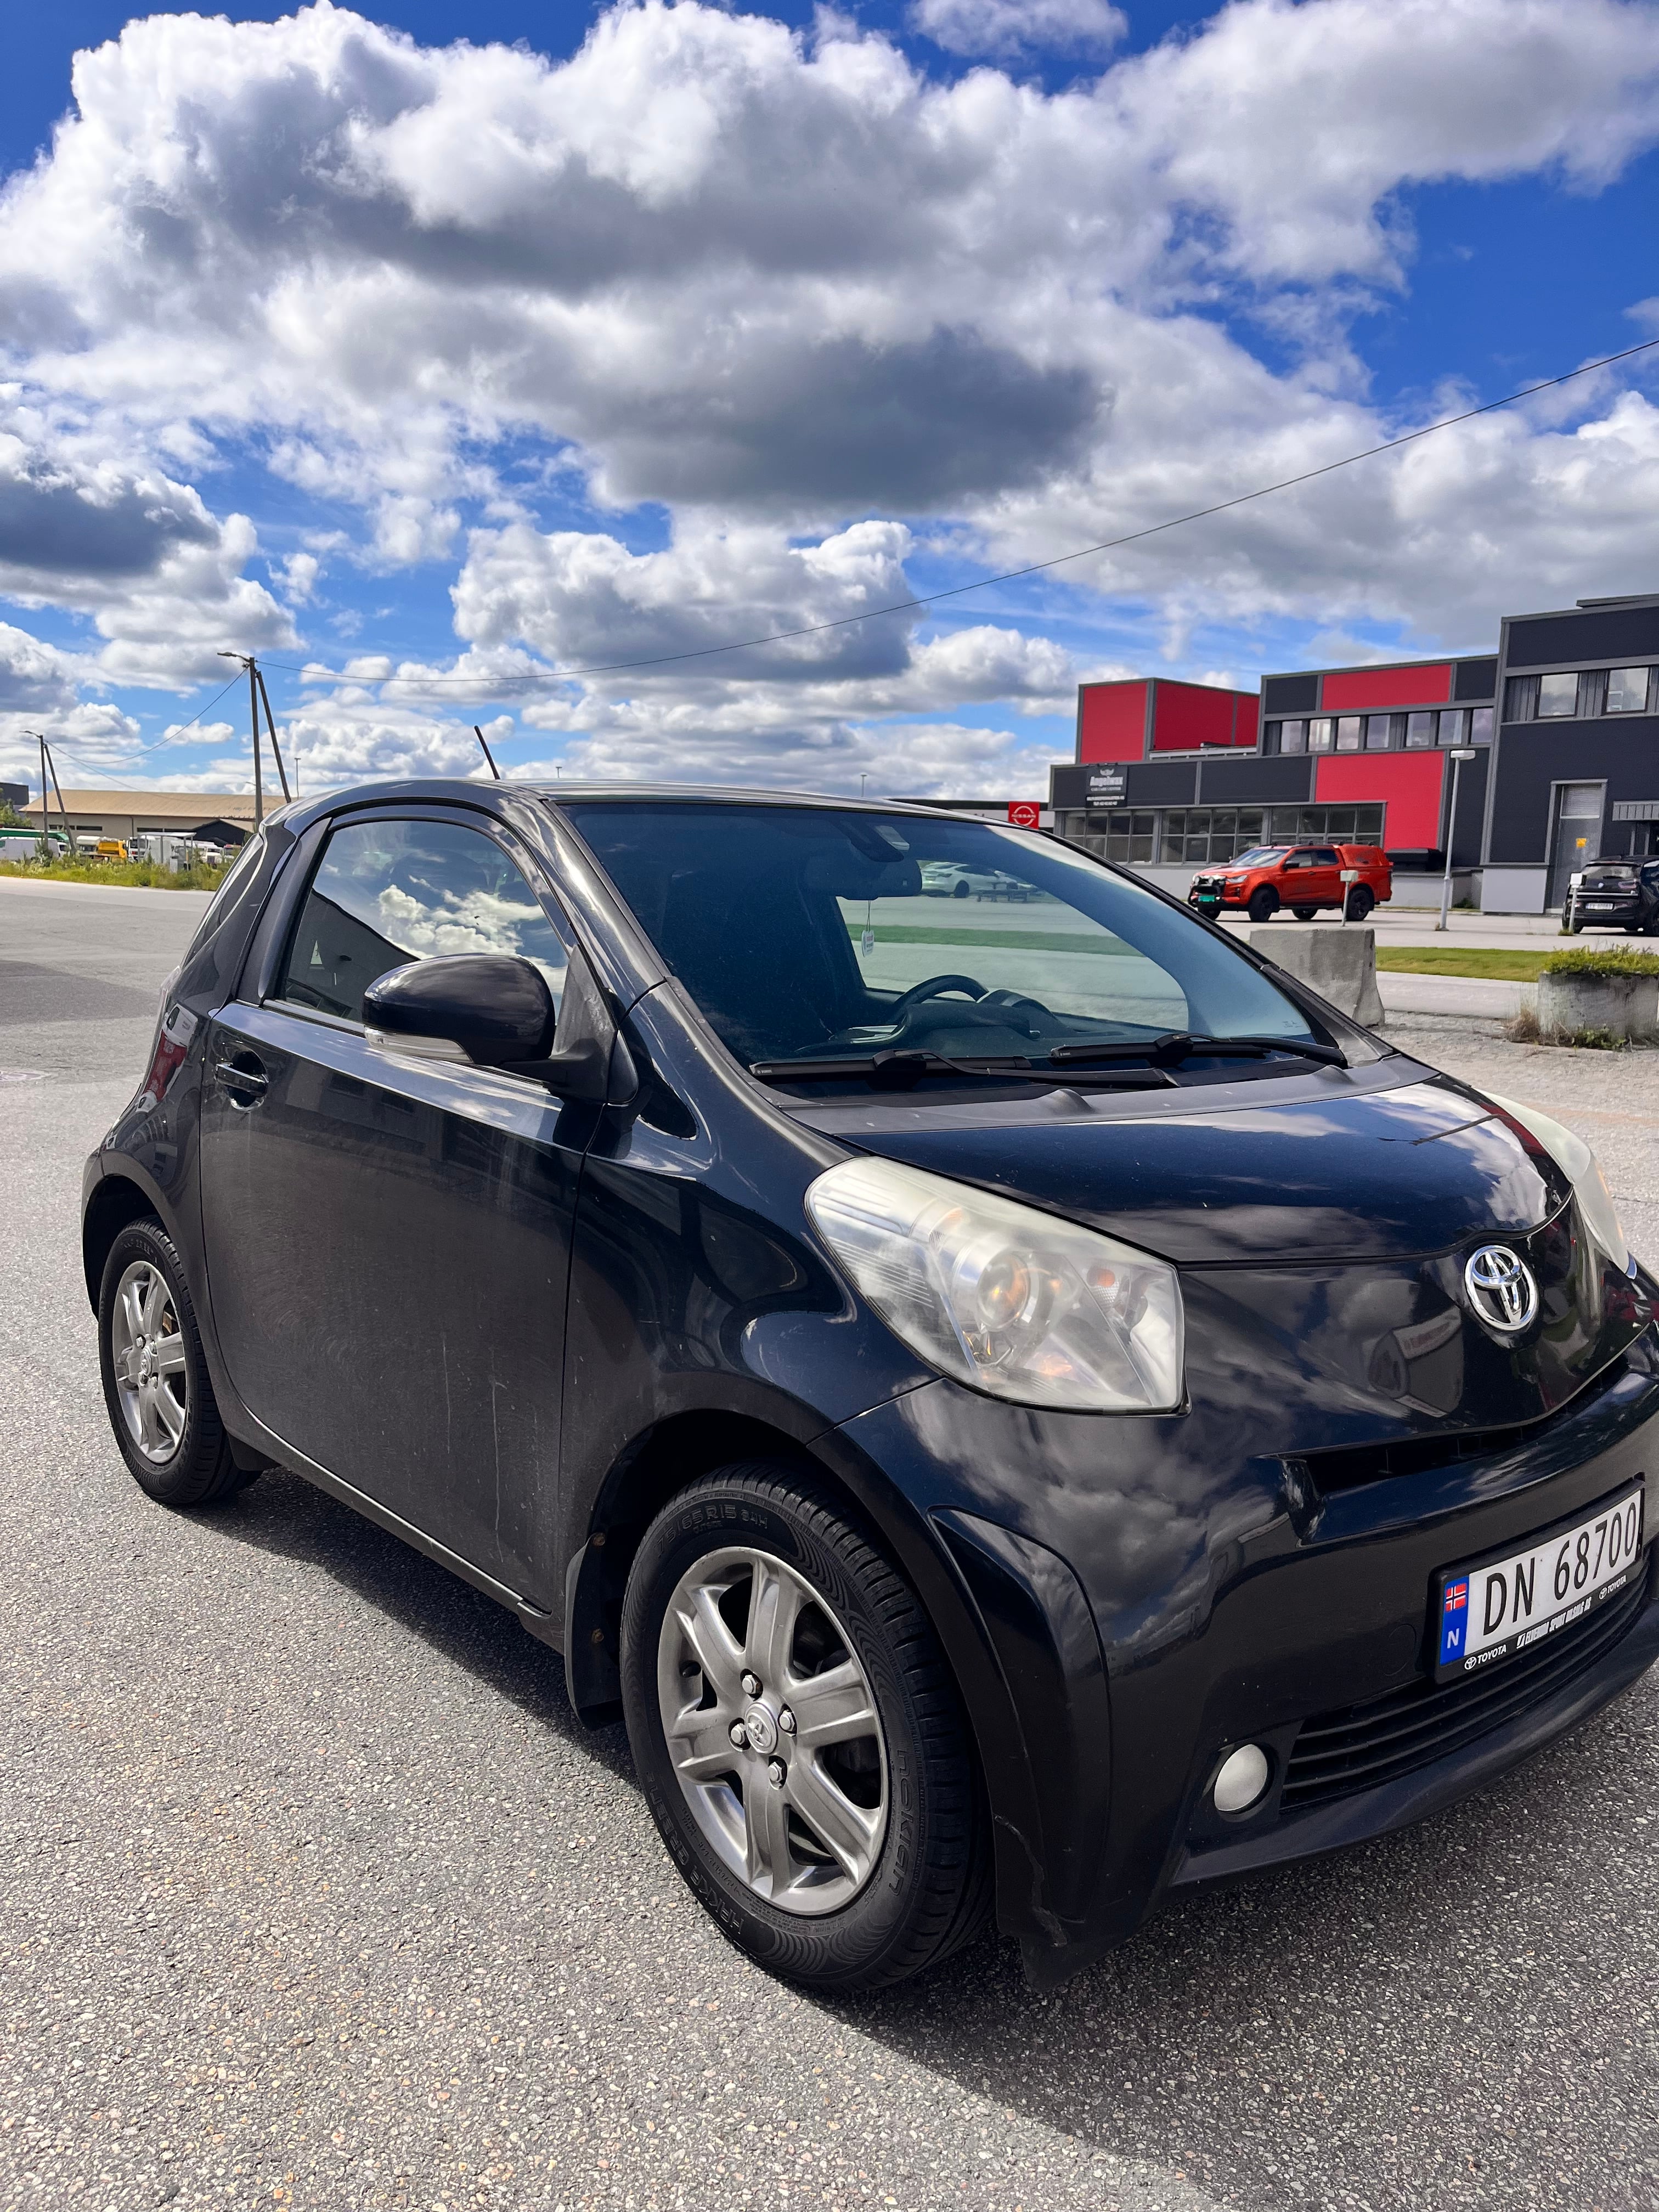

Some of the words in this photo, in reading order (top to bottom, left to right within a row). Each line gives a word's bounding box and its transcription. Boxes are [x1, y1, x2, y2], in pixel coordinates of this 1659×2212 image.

[1483, 1557, 1535, 1636] DN
[1554, 1502, 1636, 1601] 68700
[1607, 1575, 1627, 1594] TOYOTA
[1447, 1627, 1459, 1649] N
[1477, 1644, 1507, 1664] TOYOTA
